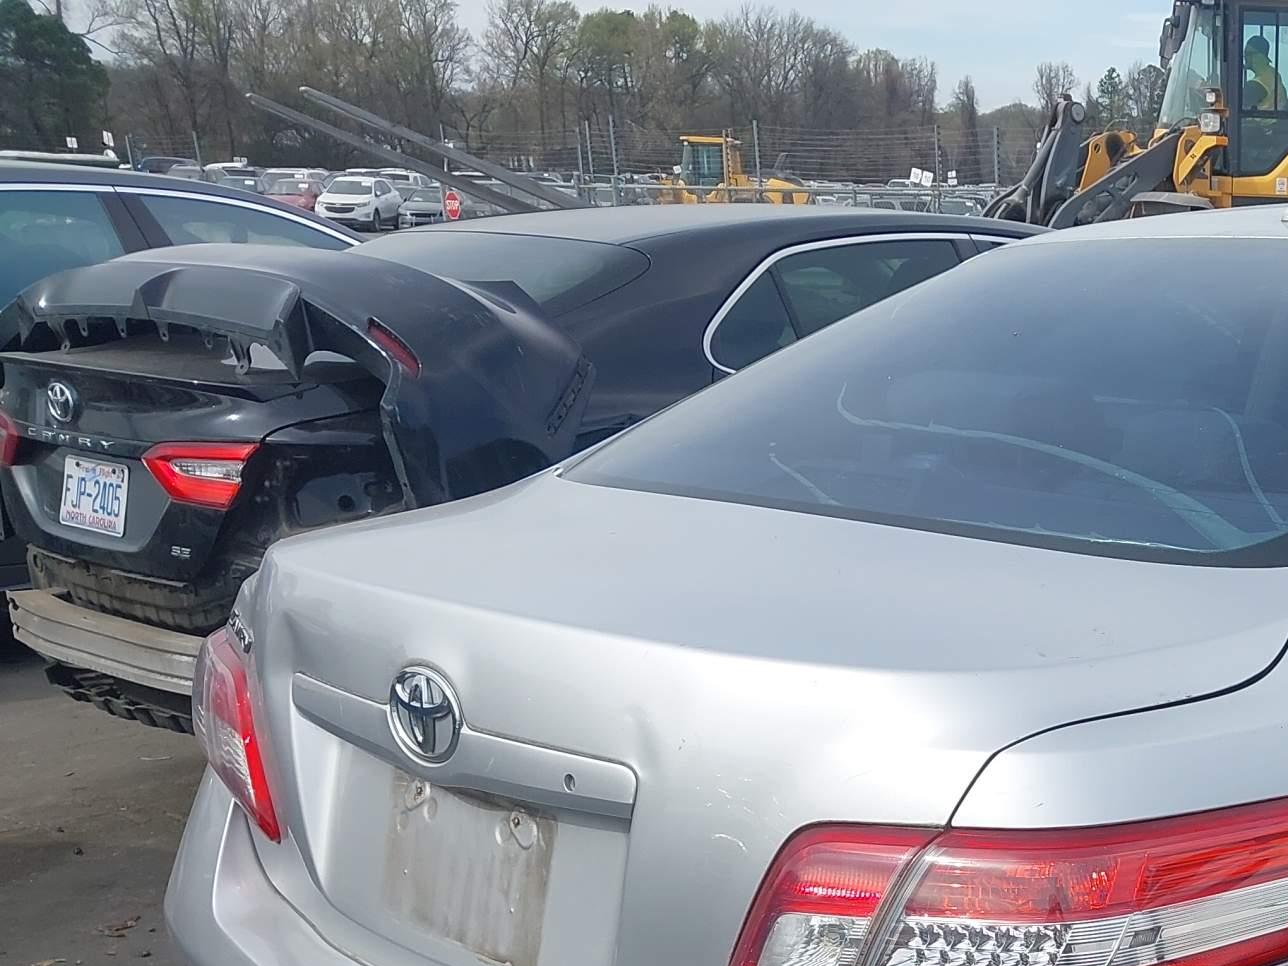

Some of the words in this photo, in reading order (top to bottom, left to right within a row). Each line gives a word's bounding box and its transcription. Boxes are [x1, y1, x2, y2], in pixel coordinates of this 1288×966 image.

[446, 199, 459, 210] STOP
[28, 427, 116, 449] CAMRY
[63, 473, 123, 518] FJP-2405
[65, 510, 87, 524] NORTH
[88, 515, 117, 530] CAROLINA
[170, 545, 192, 559] SE
